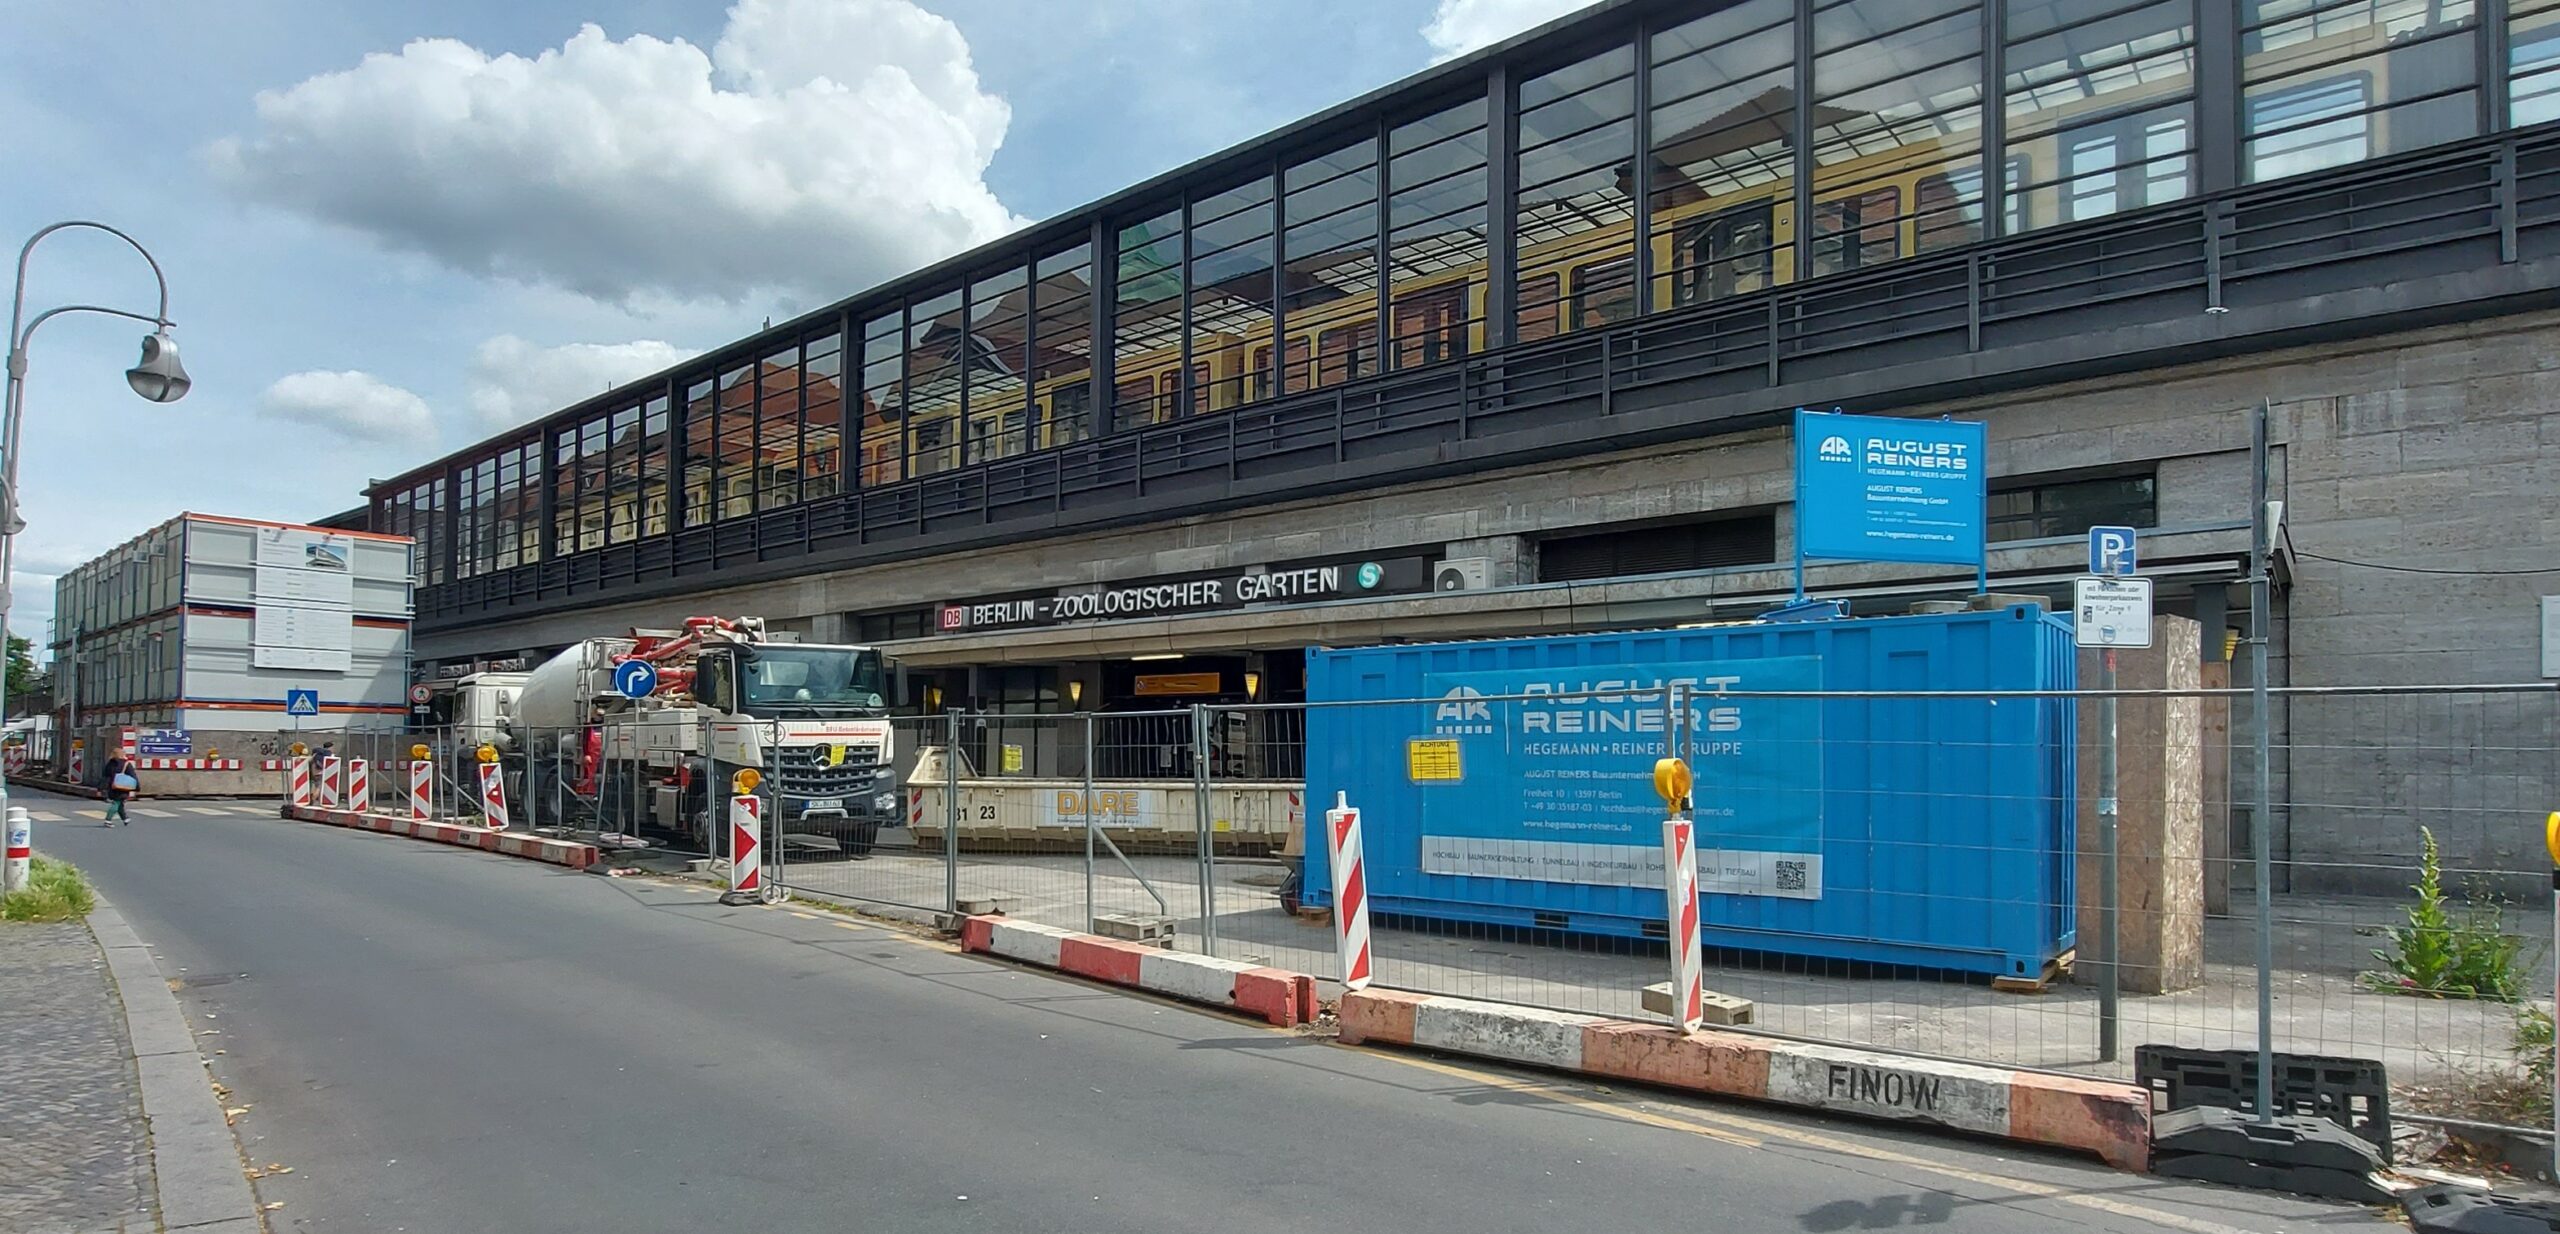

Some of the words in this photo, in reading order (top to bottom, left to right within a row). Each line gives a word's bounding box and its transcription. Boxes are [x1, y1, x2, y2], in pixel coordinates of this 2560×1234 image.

[1867, 438, 1967, 455] AUGUST
[1867, 453, 1967, 469] REINERS
[1866, 485, 1894, 493] AUGUST
[2100, 533, 2125, 568] P
[945, 609, 961, 627] DB
[973, 600, 1035, 626] BERLIN
[1052, 580, 1222, 618] ZOOLOGISCHER
[1236, 566, 1339, 601] GARTEN
[1521, 676, 1742, 706] AUGUST
[1522, 707, 1742, 734] REINERS
[1524, 742, 1601, 756] HEGEMANN
[1611, 742, 1665, 756] REINER
[1524, 770, 1555, 779] AUGUST
[1557, 770, 1591, 779] REINERS
[1057, 791, 1139, 816] DARE
[1523, 789, 1553, 798] Freiheit
[1555, 790, 1565, 798] 10
[1574, 790, 1596, 799] 13597
[1598, 791, 1623, 800] Berlin
[980, 806, 996, 820] 23
[1432, 852, 1461, 861] HOCHBAU
[1542, 857, 1580, 867] TUNNELBAU
[1726, 868, 1757, 877] TIEFBAU
[1829, 1065, 1940, 1110] FINOW
